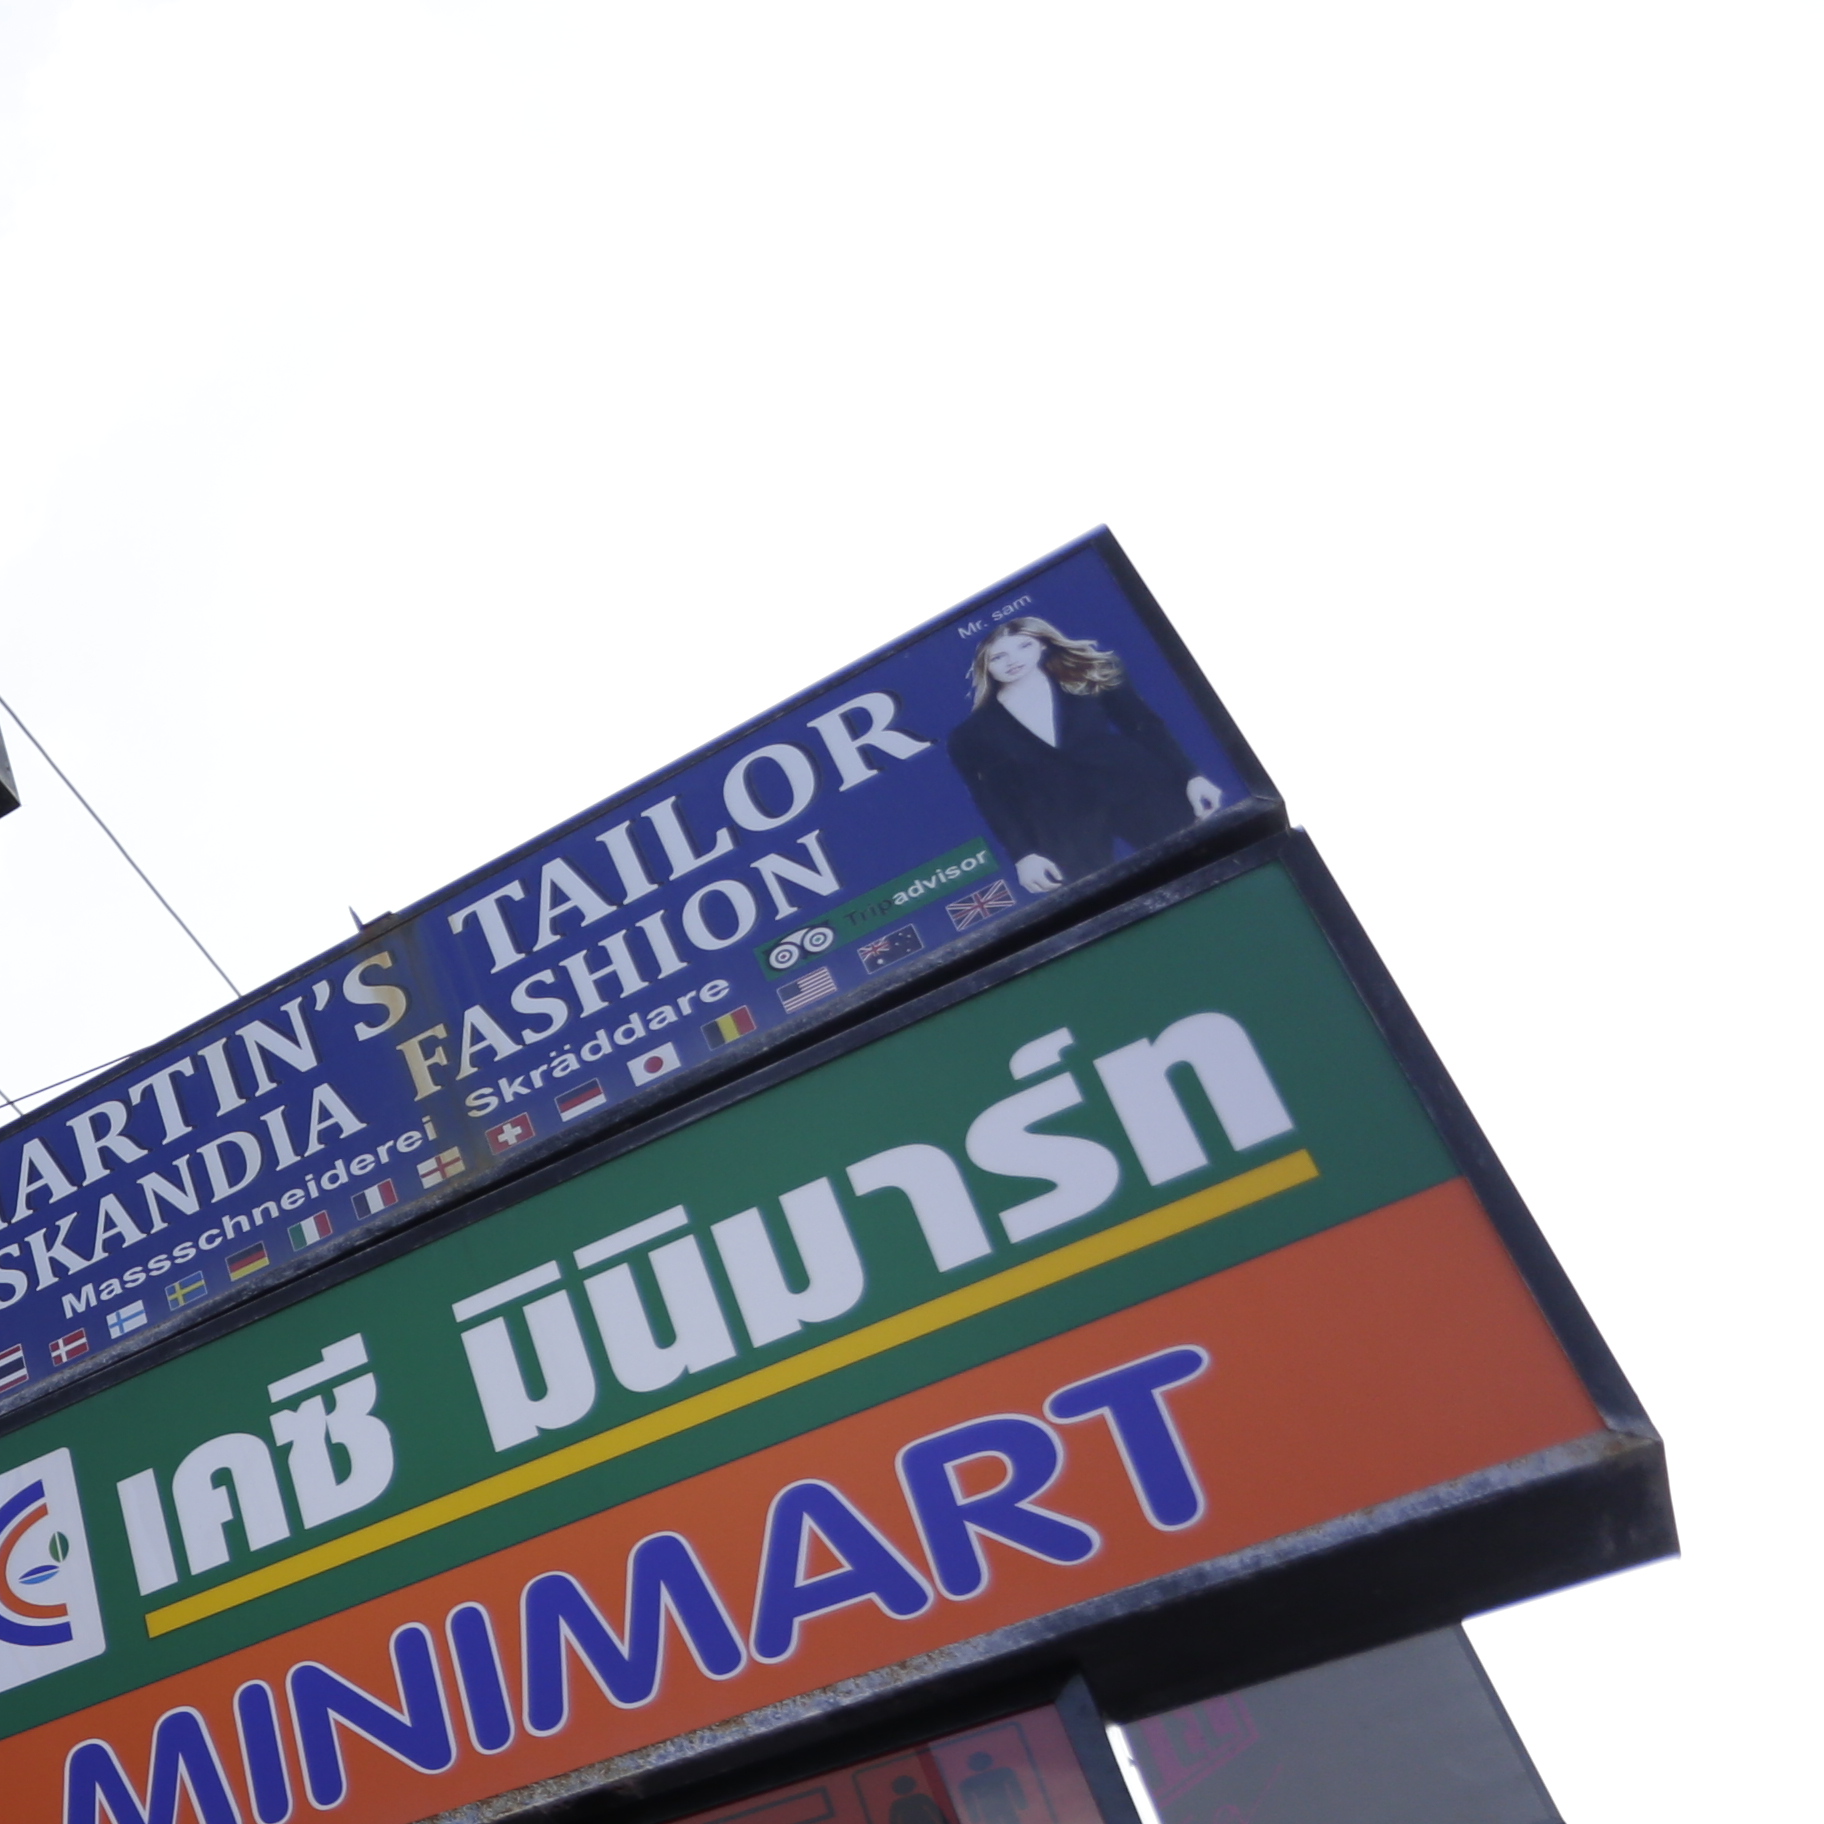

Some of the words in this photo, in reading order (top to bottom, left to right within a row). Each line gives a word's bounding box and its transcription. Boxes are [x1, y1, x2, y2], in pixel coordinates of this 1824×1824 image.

[956, 617, 988, 641] Mr.
[395, 828, 841, 1102] FASHION
[447, 690, 936, 976] TAILOR
[60, 1115, 440, 1319] Massschneiderei
[463, 978, 731, 1120] Skräddare
[119, 1330, 398, 1598] เคซี
[450, 1008, 1295, 1453] มินิมาร์ท
